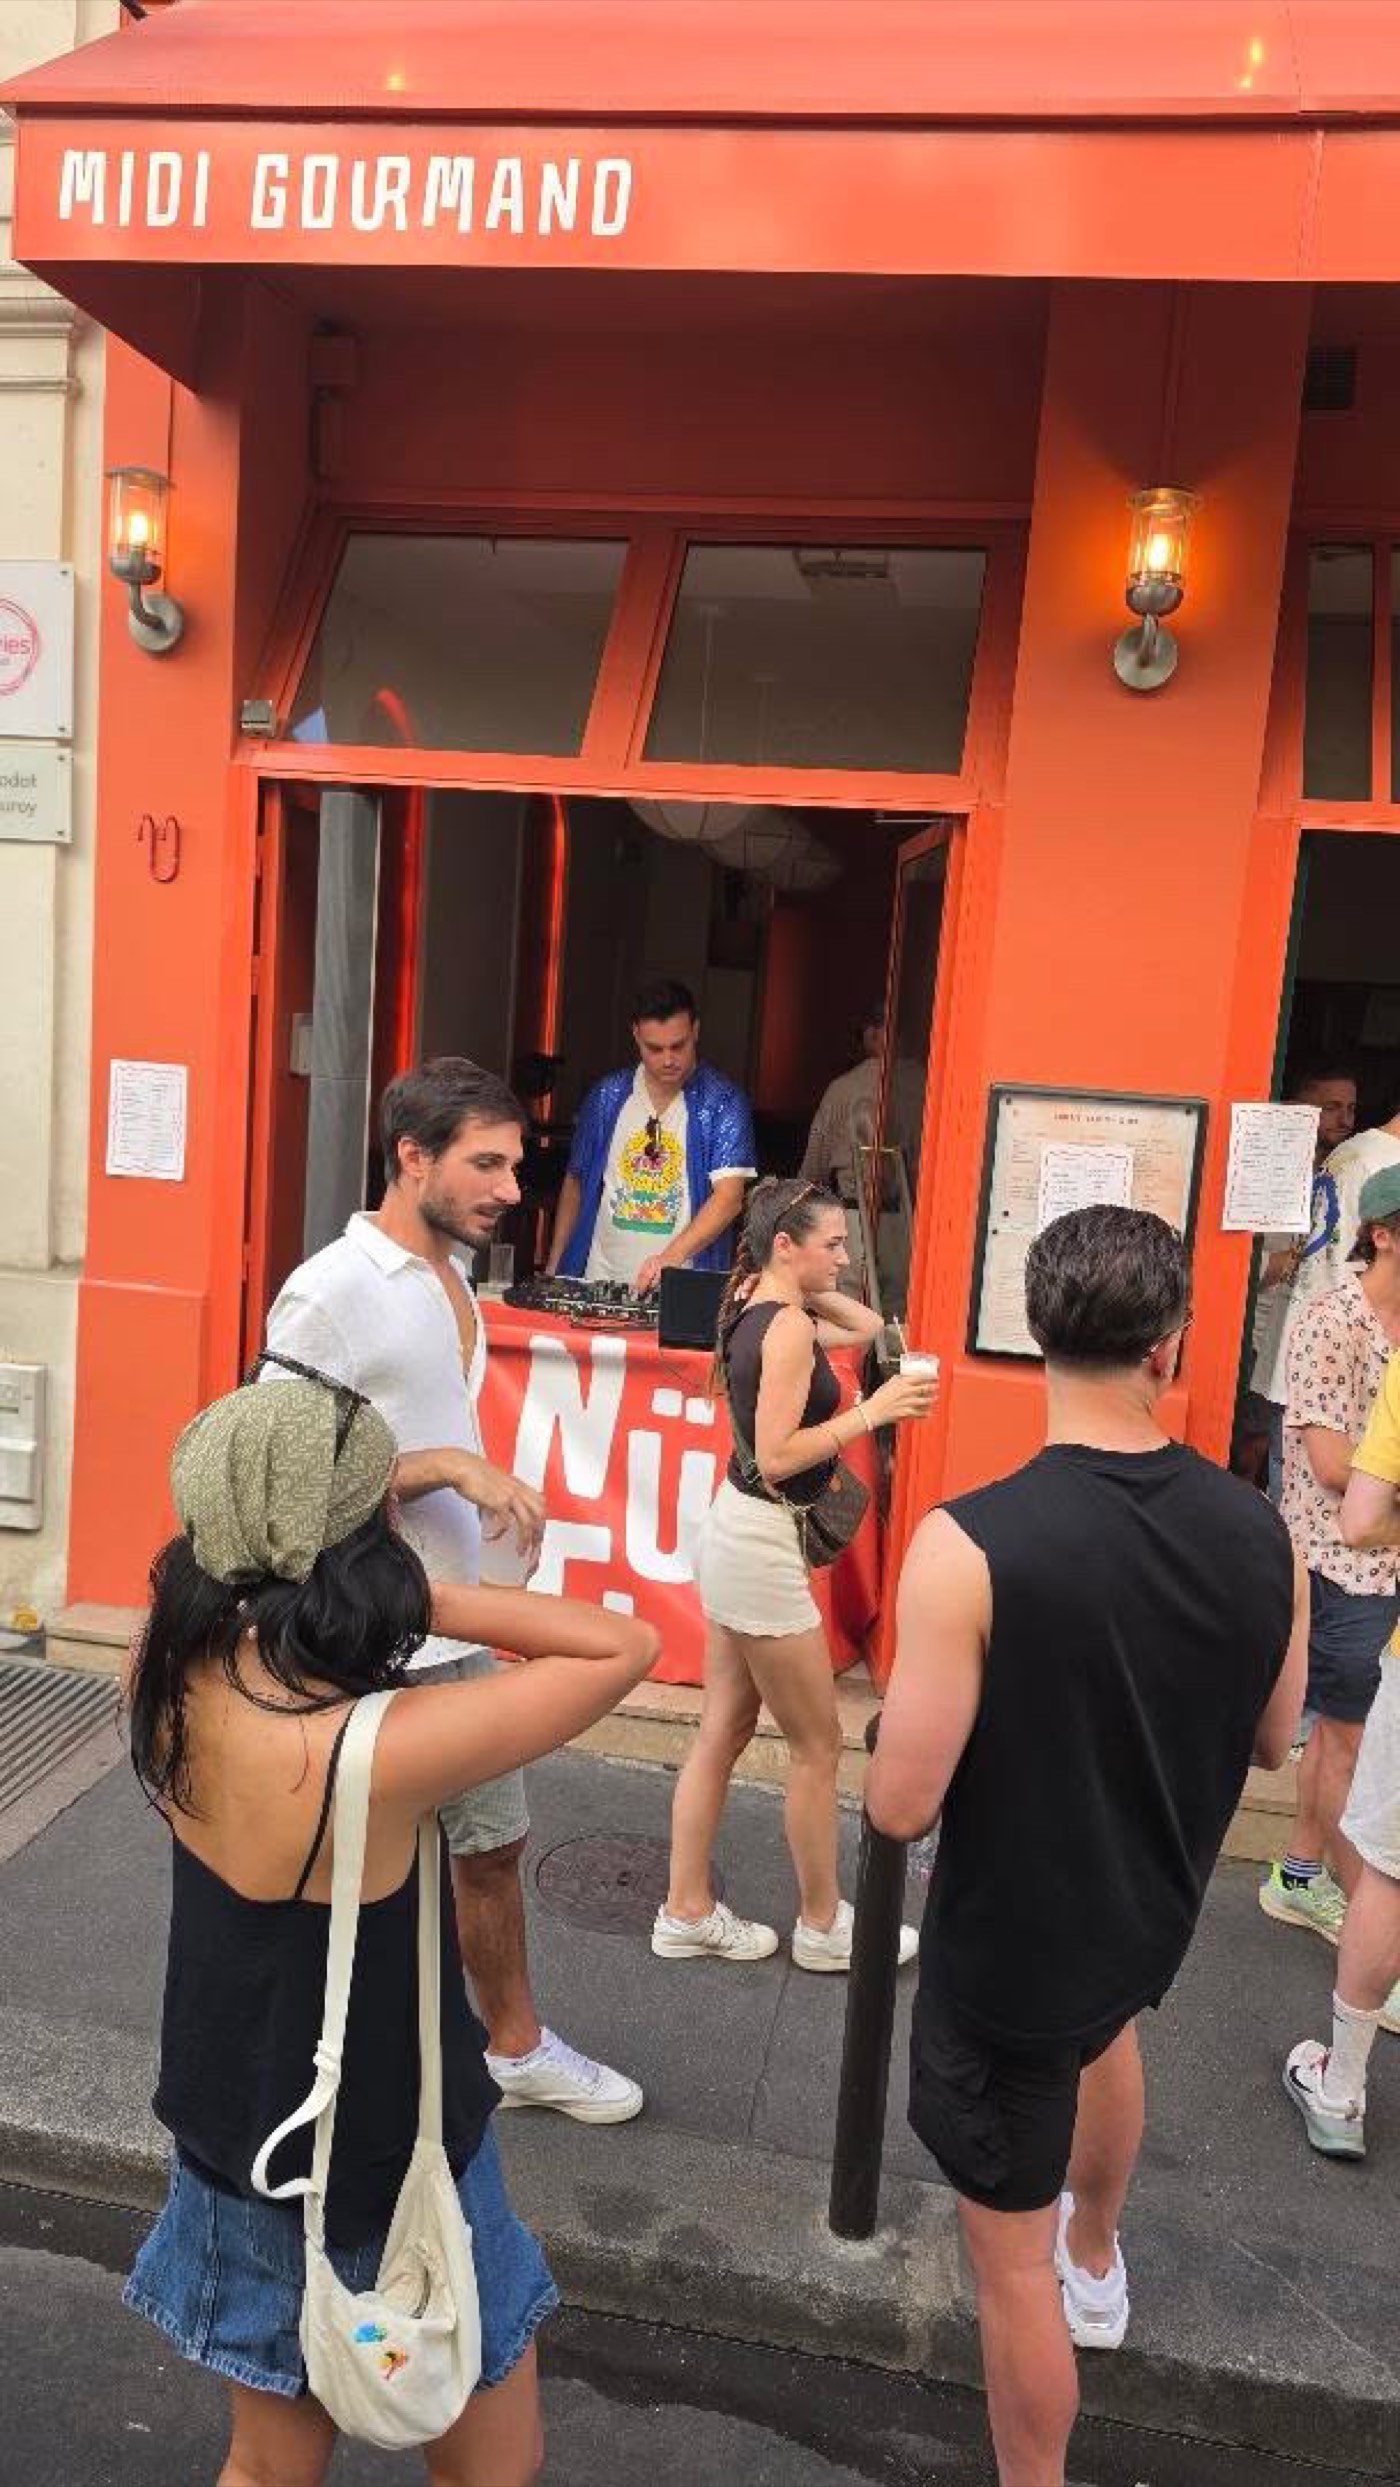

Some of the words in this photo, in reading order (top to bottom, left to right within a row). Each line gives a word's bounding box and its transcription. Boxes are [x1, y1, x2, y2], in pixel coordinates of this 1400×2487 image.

[58, 149, 210, 227] MIDI
[250, 153, 633, 237] GOURMAND
[0, 634, 31, 655] ies
